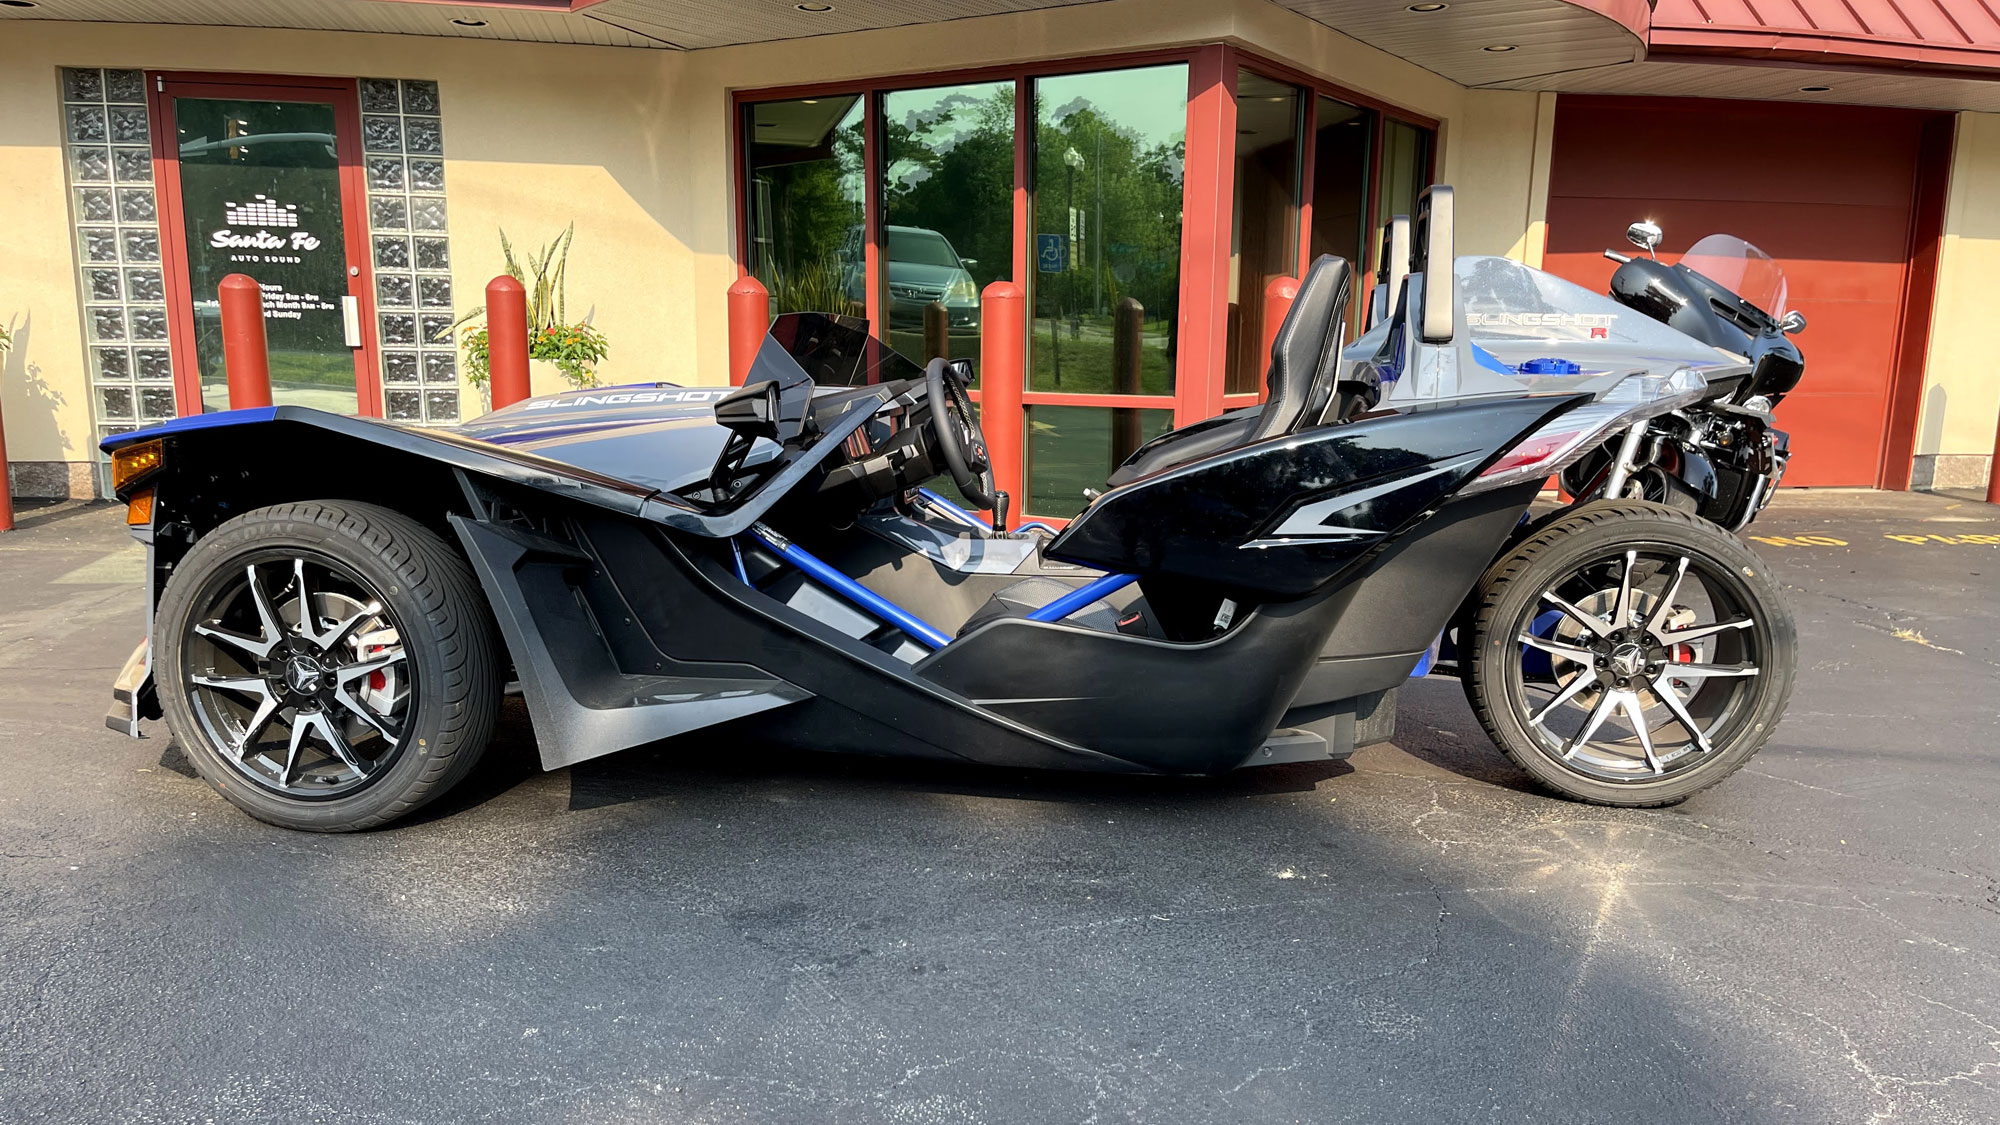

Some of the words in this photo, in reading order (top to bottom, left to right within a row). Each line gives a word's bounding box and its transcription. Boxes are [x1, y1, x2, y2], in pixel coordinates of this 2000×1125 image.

[210, 229, 286, 249] Santa
[290, 231, 320, 250] Fe
[230, 254, 260, 263] AUTO
[264, 255, 301, 264] SOUND
[276, 301, 300, 309] Month
[272, 310, 302, 320] Sunday
[1466, 312, 1618, 327] SLINGSHOT
[525, 391, 735, 410] SLINGSHOT
